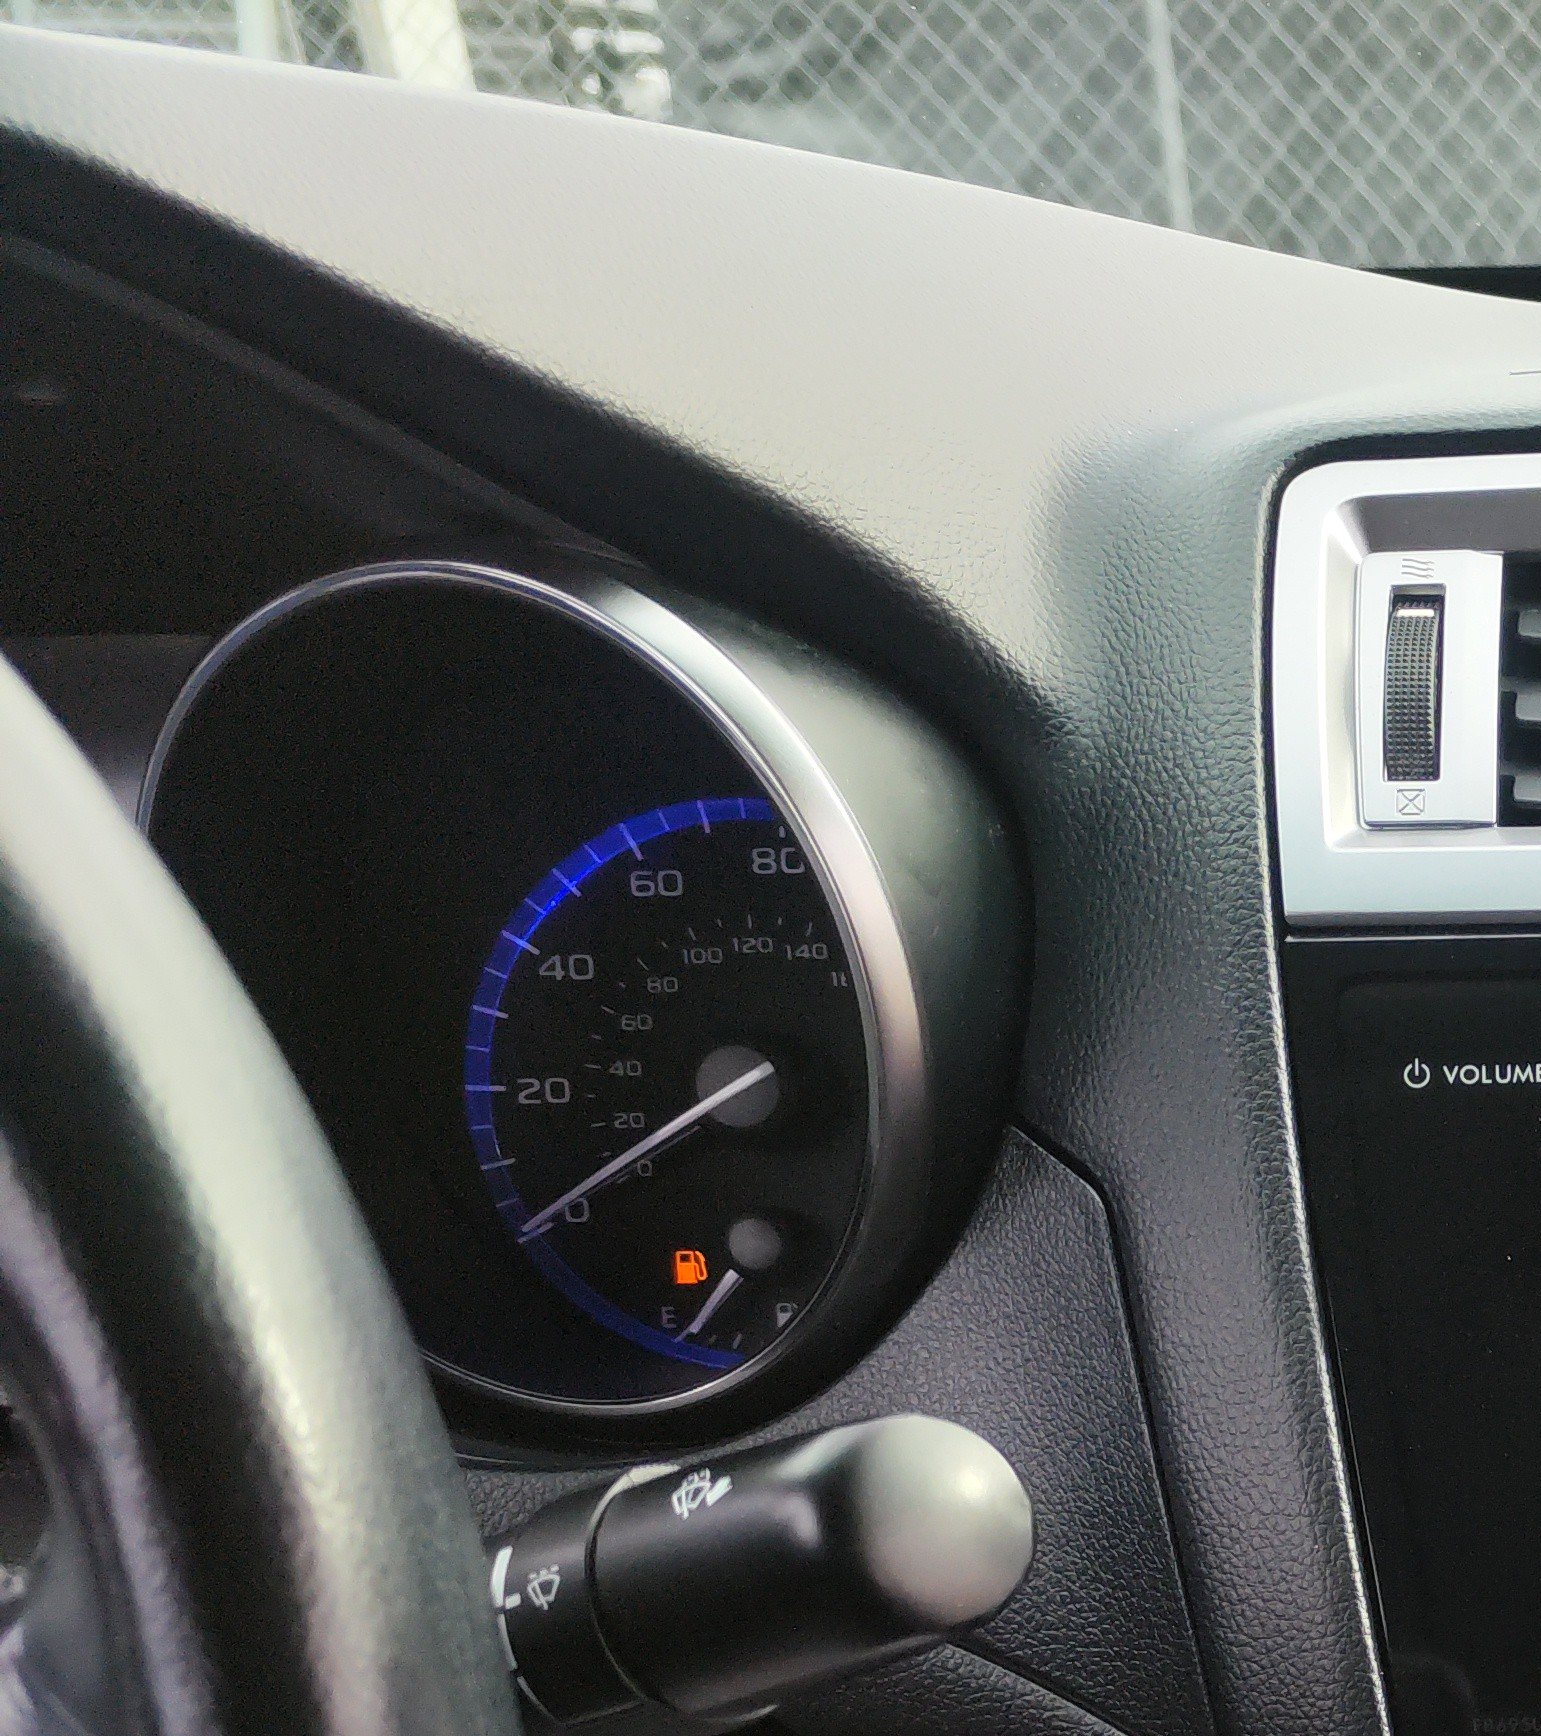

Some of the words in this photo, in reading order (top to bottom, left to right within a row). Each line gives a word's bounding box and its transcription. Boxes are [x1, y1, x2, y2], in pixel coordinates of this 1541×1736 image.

[752, 847, 805, 875] 80
[630, 869, 683, 897] 60
[732, 936, 774, 954] 120
[785, 942, 828, 961] 140
[682, 947, 723, 965] 100
[538, 954, 594, 981] 40
[646, 976, 679, 994] 80
[620, 1013, 653, 1031] 60
[608, 1060, 642, 1077] 40
[517, 1077, 571, 1105] 20
[613, 1112, 645, 1129] 20
[564, 1198, 590, 1224] 0
[661, 1306, 677, 1329] E
